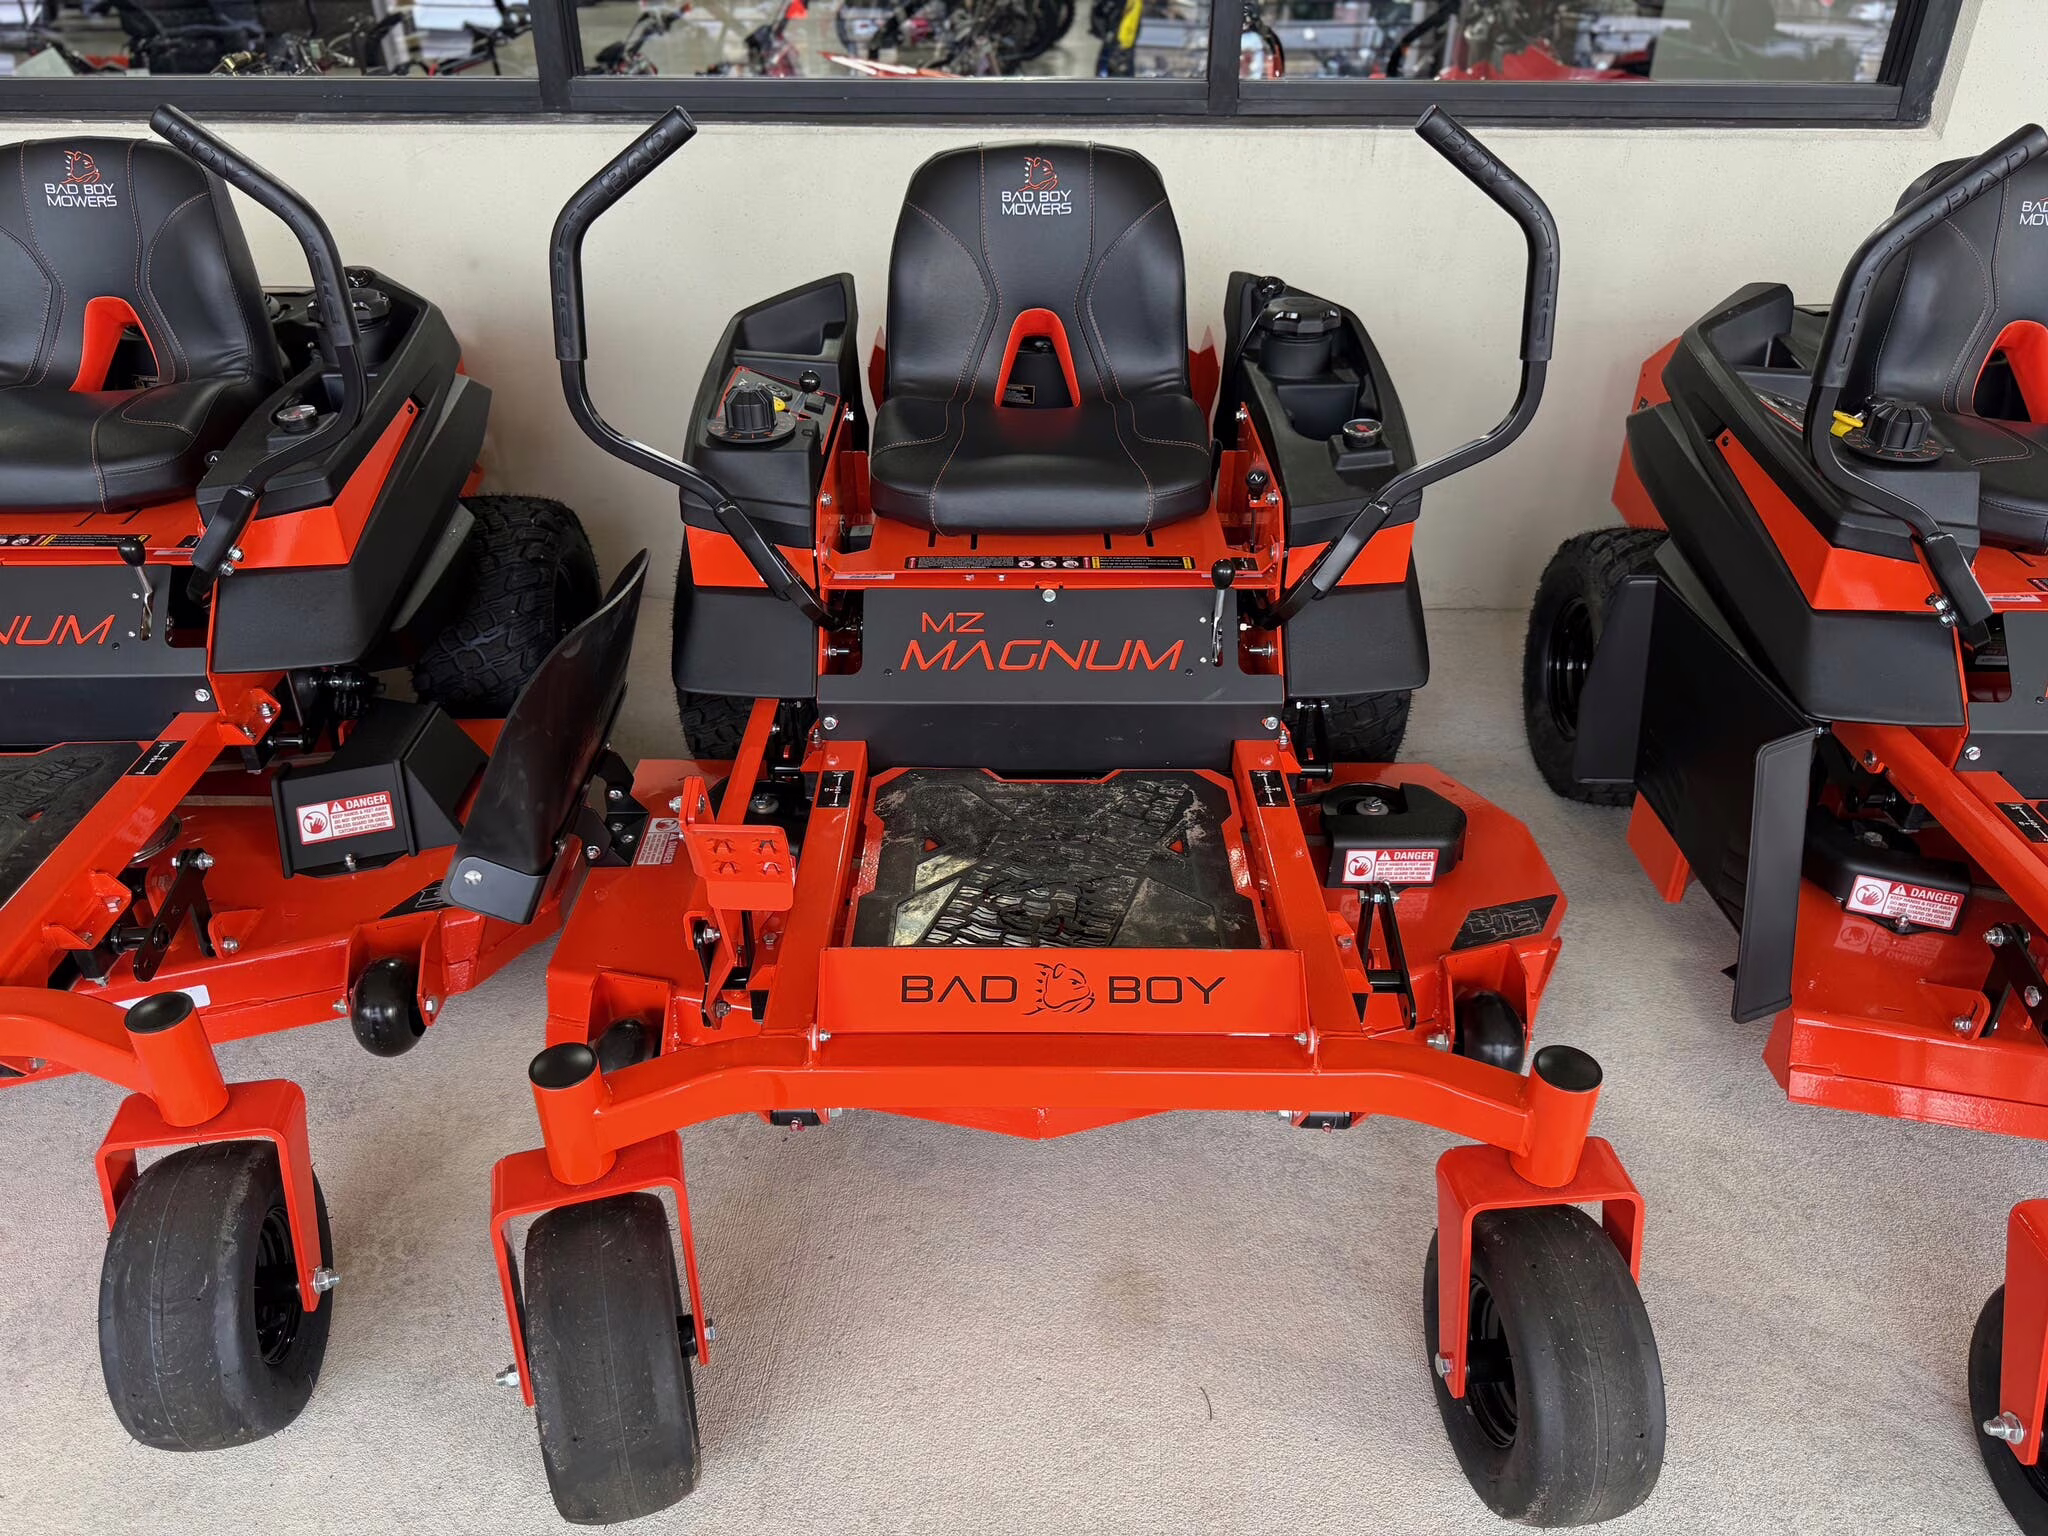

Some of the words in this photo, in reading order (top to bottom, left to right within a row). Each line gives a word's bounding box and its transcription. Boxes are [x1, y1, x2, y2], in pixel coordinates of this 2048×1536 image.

[600, 127, 672, 196] BAD
[1440, 123, 1513, 187] BOY
[44, 183, 79, 194] BAD
[83, 183, 114, 195] BOY
[1002, 191, 1034, 202] BAD
[1040, 189, 1072, 202] BOY
[46, 194, 118, 208] MOWERS
[1002, 202, 1072, 216] MOWERS
[2019, 212, 2048, 226] MO
[921, 611, 985, 633] MZ
[900, 639, 1185, 671] MAGNUM
[346, 795, 386, 809] DANGER
[1910, 888, 1958, 904] DANGER
[901, 975, 1017, 1003] BAD
[1108, 976, 1226, 1004] BOY
